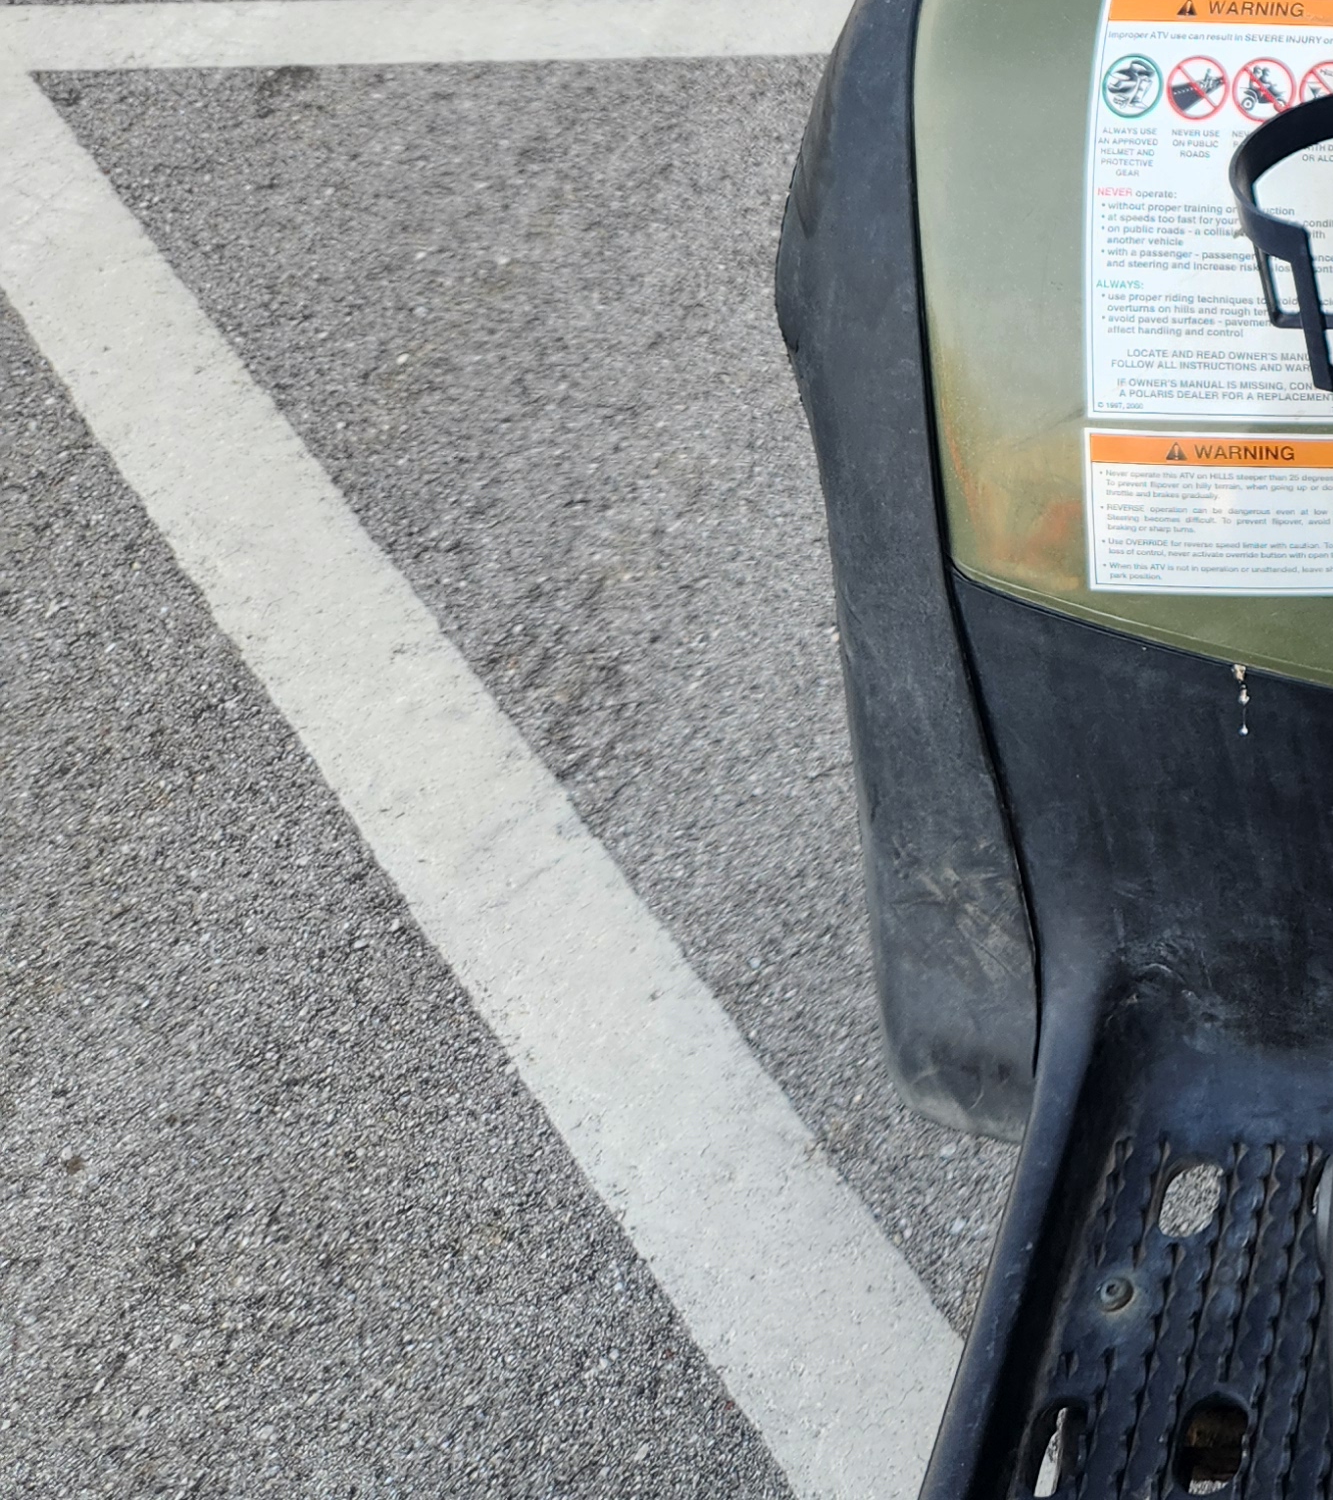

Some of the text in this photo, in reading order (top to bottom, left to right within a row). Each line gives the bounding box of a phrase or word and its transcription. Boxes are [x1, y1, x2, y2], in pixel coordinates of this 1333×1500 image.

[1208, 0, 1304, 18] WARNING
[1109, 31, 1148, 40] Improper
[1150, 31, 1169, 39] ATV
[1188, 32, 1204, 40] can
[1206, 32, 1233, 40] result
[1245, 33, 1284, 43] SEVERE
[1286, 35, 1322, 44] INJURY
[1103, 127, 1138, 135] ALWAYS
[1098, 137, 1158, 146] AN APPROVED
[1188, 140, 1219, 148] PUBLIC
[1180, 150, 1210, 158] ROADS
[1302, 154, 1315, 162] OR
[1101, 158, 1154, 167] PROTECTIVE
[1097, 187, 1177, 199] NEVER operate:
[1096, 280, 1144, 290] ALWAYS:
[1127, 349, 1277, 361] LOCATE AND READ OWNER'S
[1111, 359, 1154, 368] FOLLOW
[1157, 360, 1177, 369] ALL
[1180, 362, 1257, 371] INSTRUCTIONS
[1117, 378, 1126, 386] IF
[1129, 378, 1177, 387] OWNER'S
[1180, 379, 1224, 389] MANUAL
[1227, 380, 1237, 389] IS
[1240, 381, 1286, 391] MISSING,
[1119, 389, 1126, 397] A
[1129, 389, 1173, 398] POLARIS
[1177, 390, 1219, 400] DEALER
[1222, 391, 1244, 400] FOR
[1247, 392, 1254, 400] A
[1194, 445, 1295, 461] WARNING
[1236, 474, 1267, 482] steeper
[1107, 504, 1145, 512] REVERSE
[1126, 539, 1168, 547] OVERRIDE
